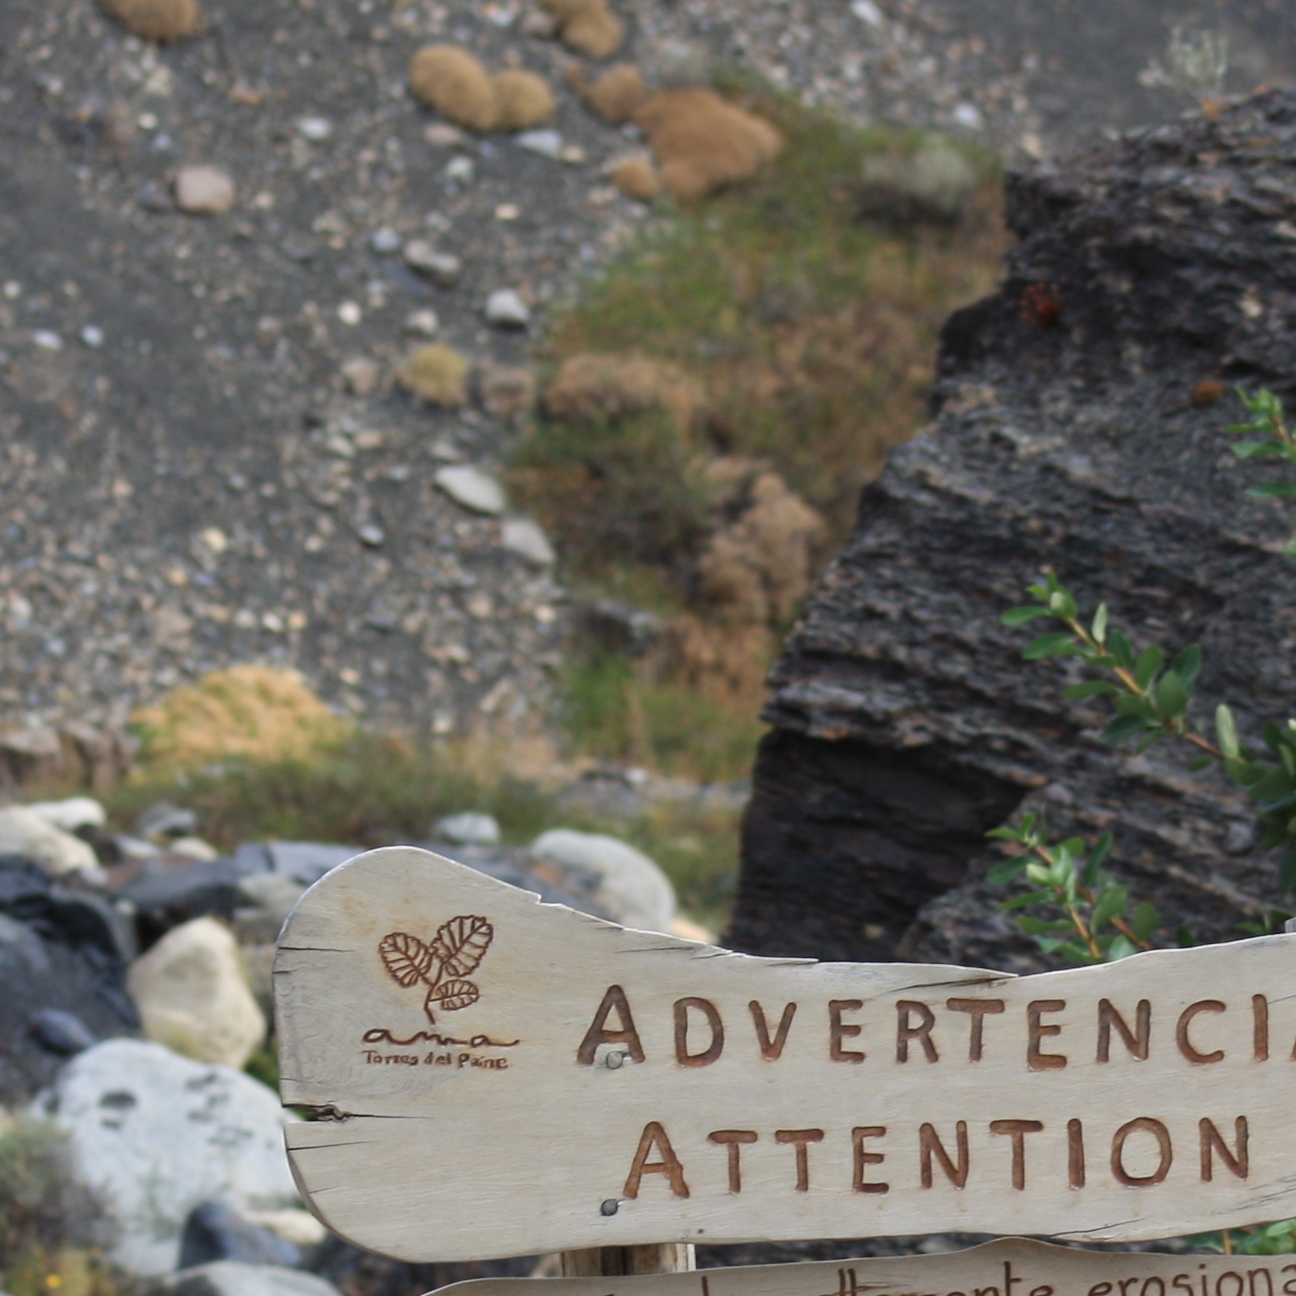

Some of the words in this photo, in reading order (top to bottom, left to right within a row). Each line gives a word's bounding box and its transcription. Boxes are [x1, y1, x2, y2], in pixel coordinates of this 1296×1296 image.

[361, 1050, 419, 1067] Torres
[424, 1052, 452, 1066] del
[623, 1115, 1249, 1199] ATTENTION
